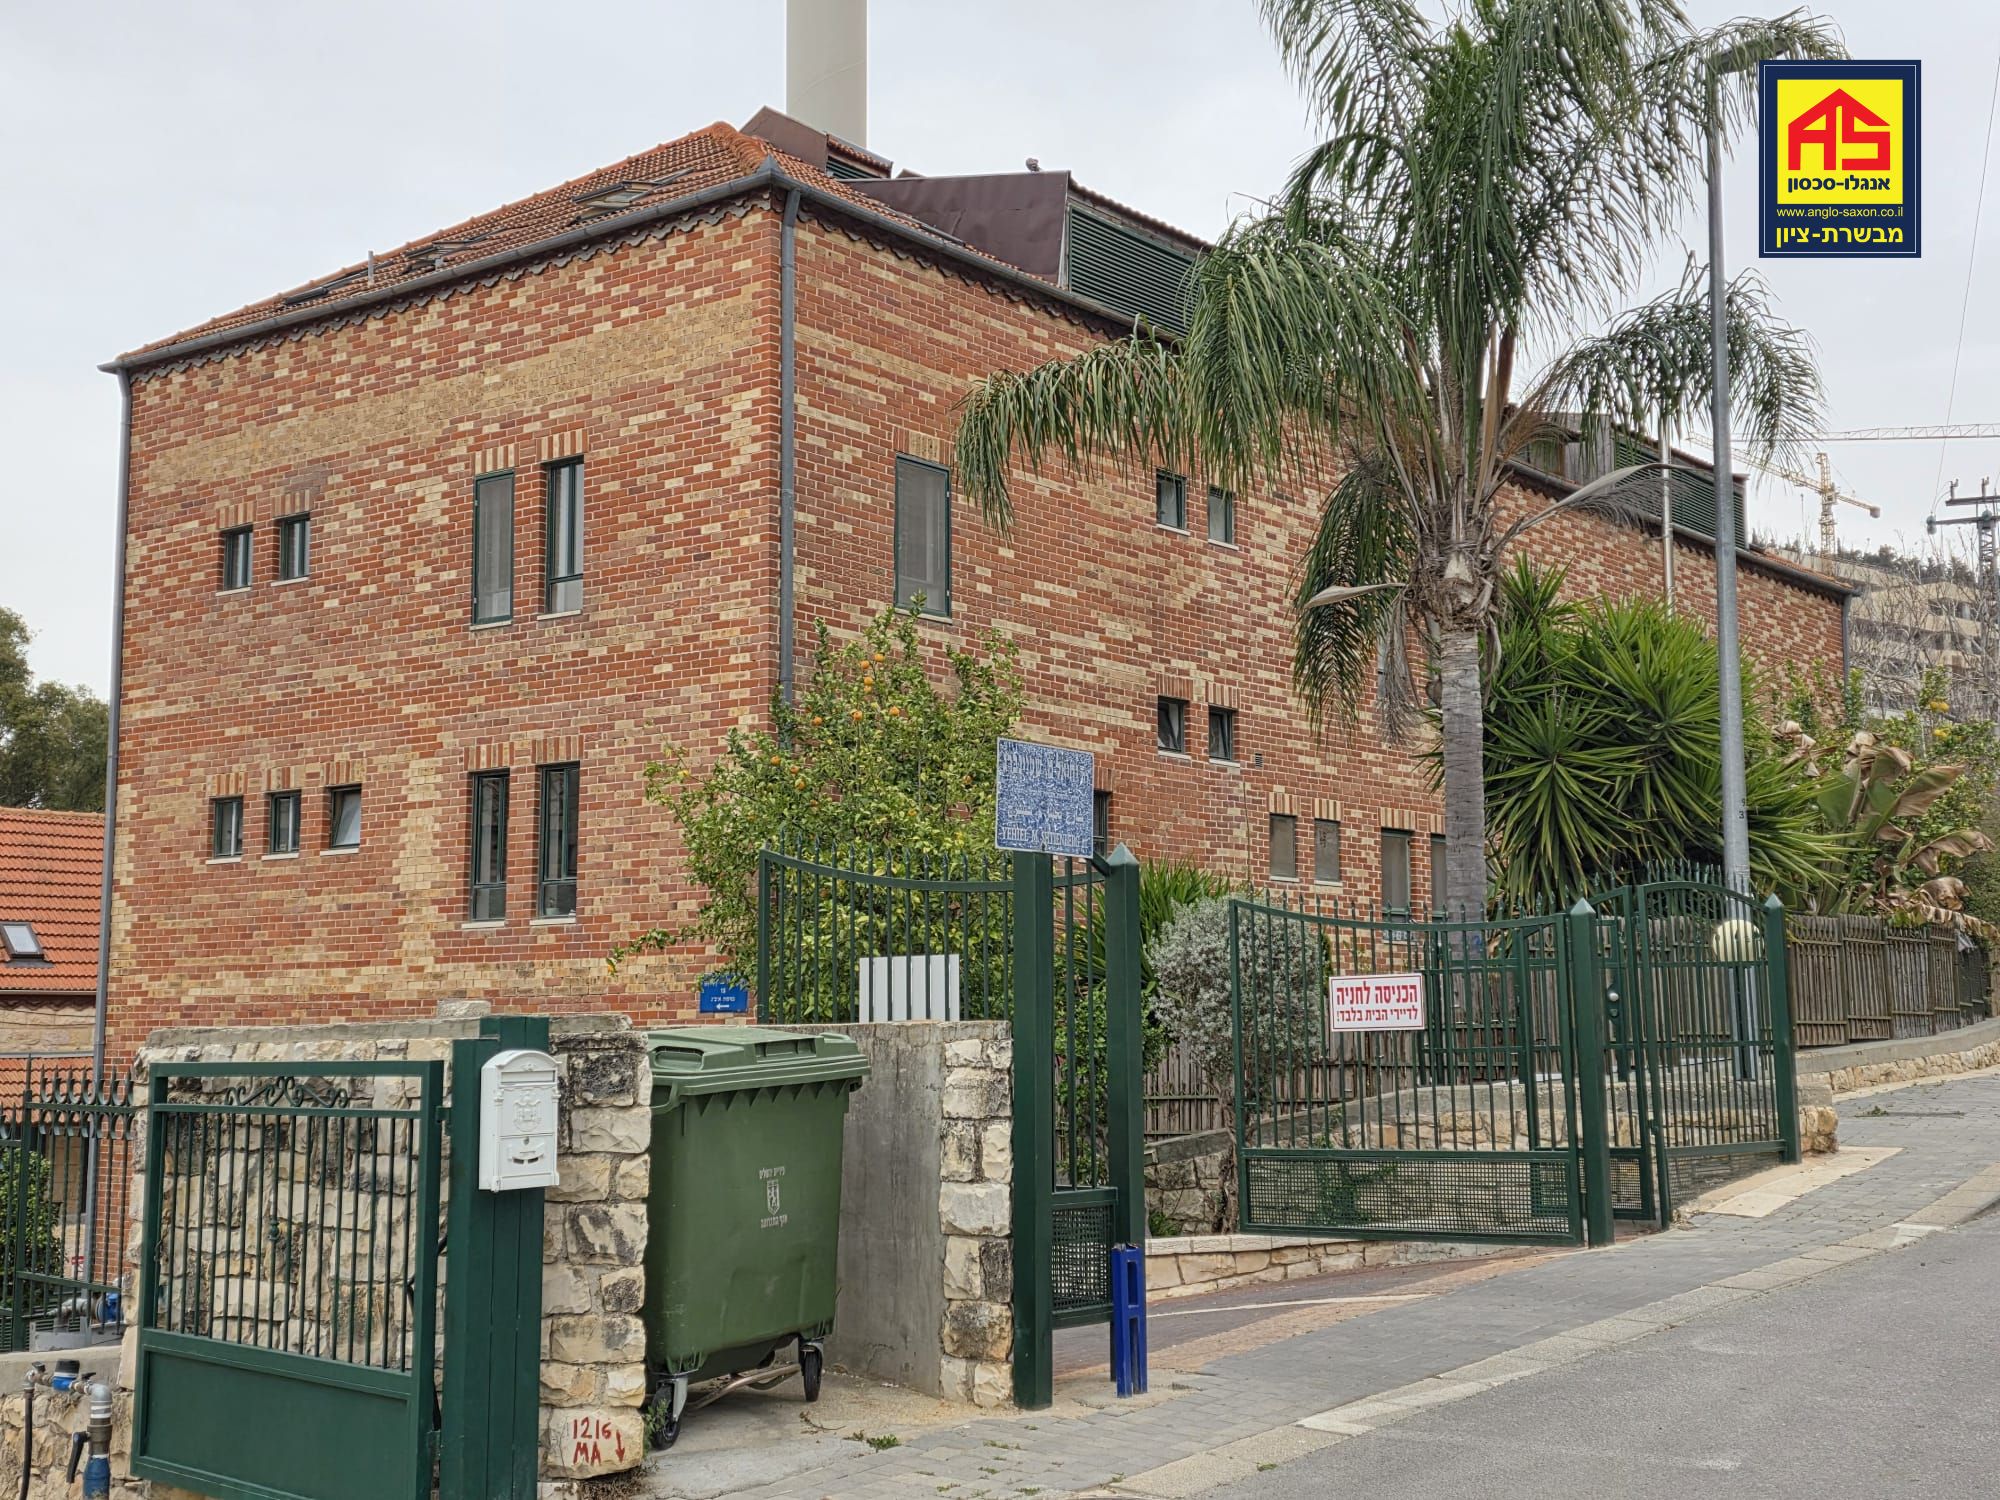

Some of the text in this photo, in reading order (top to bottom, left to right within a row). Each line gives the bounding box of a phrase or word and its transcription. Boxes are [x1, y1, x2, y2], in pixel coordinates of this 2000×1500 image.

[1336, 980, 1418, 1006] הכניסה לחניה
[1337, 1004, 1419, 1022] לדיירי הבית בלבד!
[573, 1416, 612, 1440] 1216
[572, 1441, 602, 1466] MA
